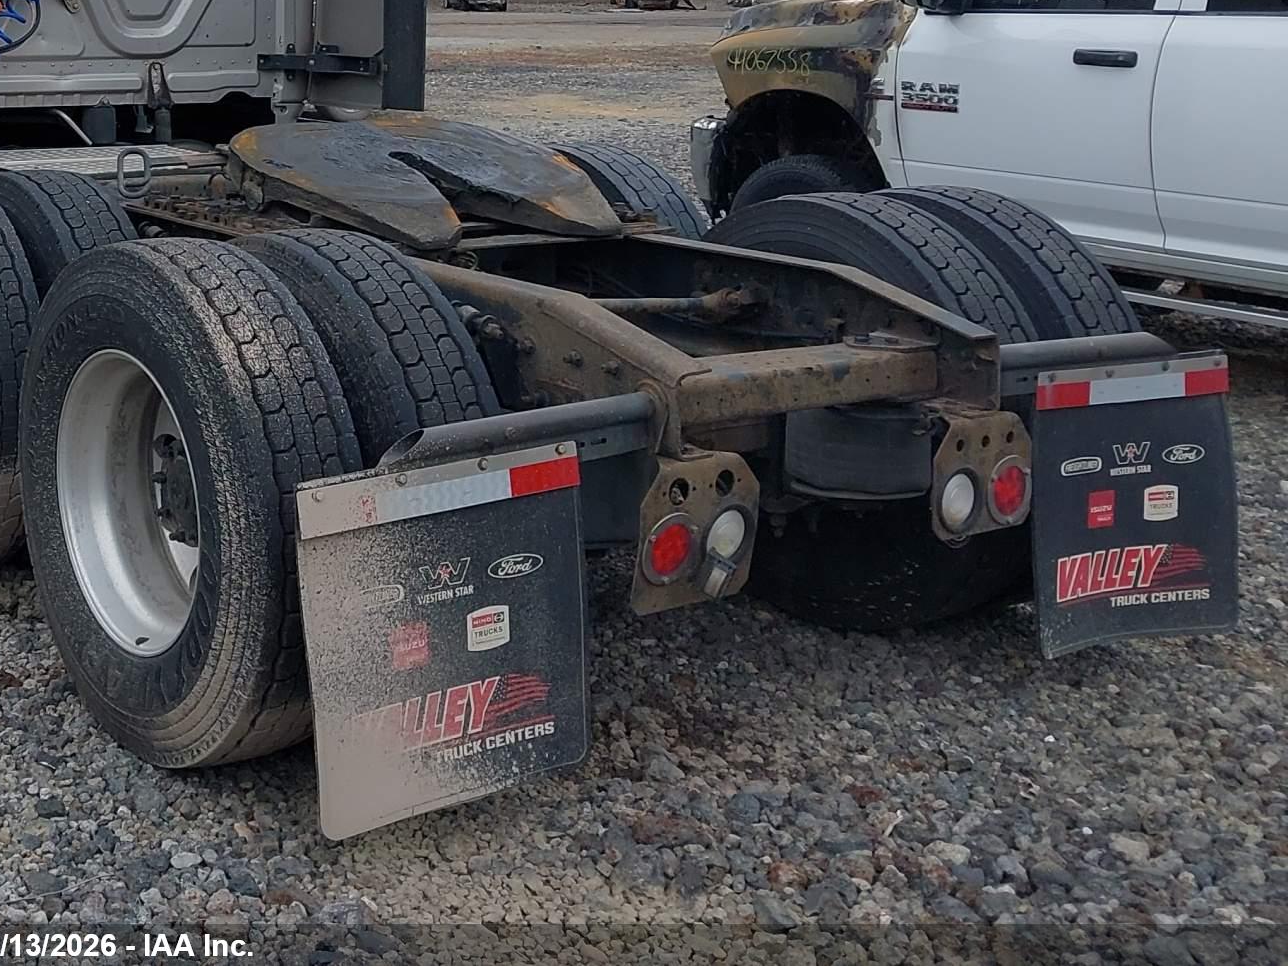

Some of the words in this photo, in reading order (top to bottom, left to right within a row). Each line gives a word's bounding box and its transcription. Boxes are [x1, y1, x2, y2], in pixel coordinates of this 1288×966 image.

[727, 46, 811, 77] 44067558
[901, 81, 960, 94] RAM
[901, 92, 959, 105] 3500
[497, 556, 532, 576] Ford
[1057, 544, 1168, 603] VALLEY
[455, 585, 474, 597] STAR
[1110, 593, 1148, 607] TRUCK
[1151, 588, 1210, 603] CENTERS
[474, 626, 503, 638] TRUCKS
[436, 740, 483, 763] TRUCK
[485, 722, 555, 750] CENTERS
